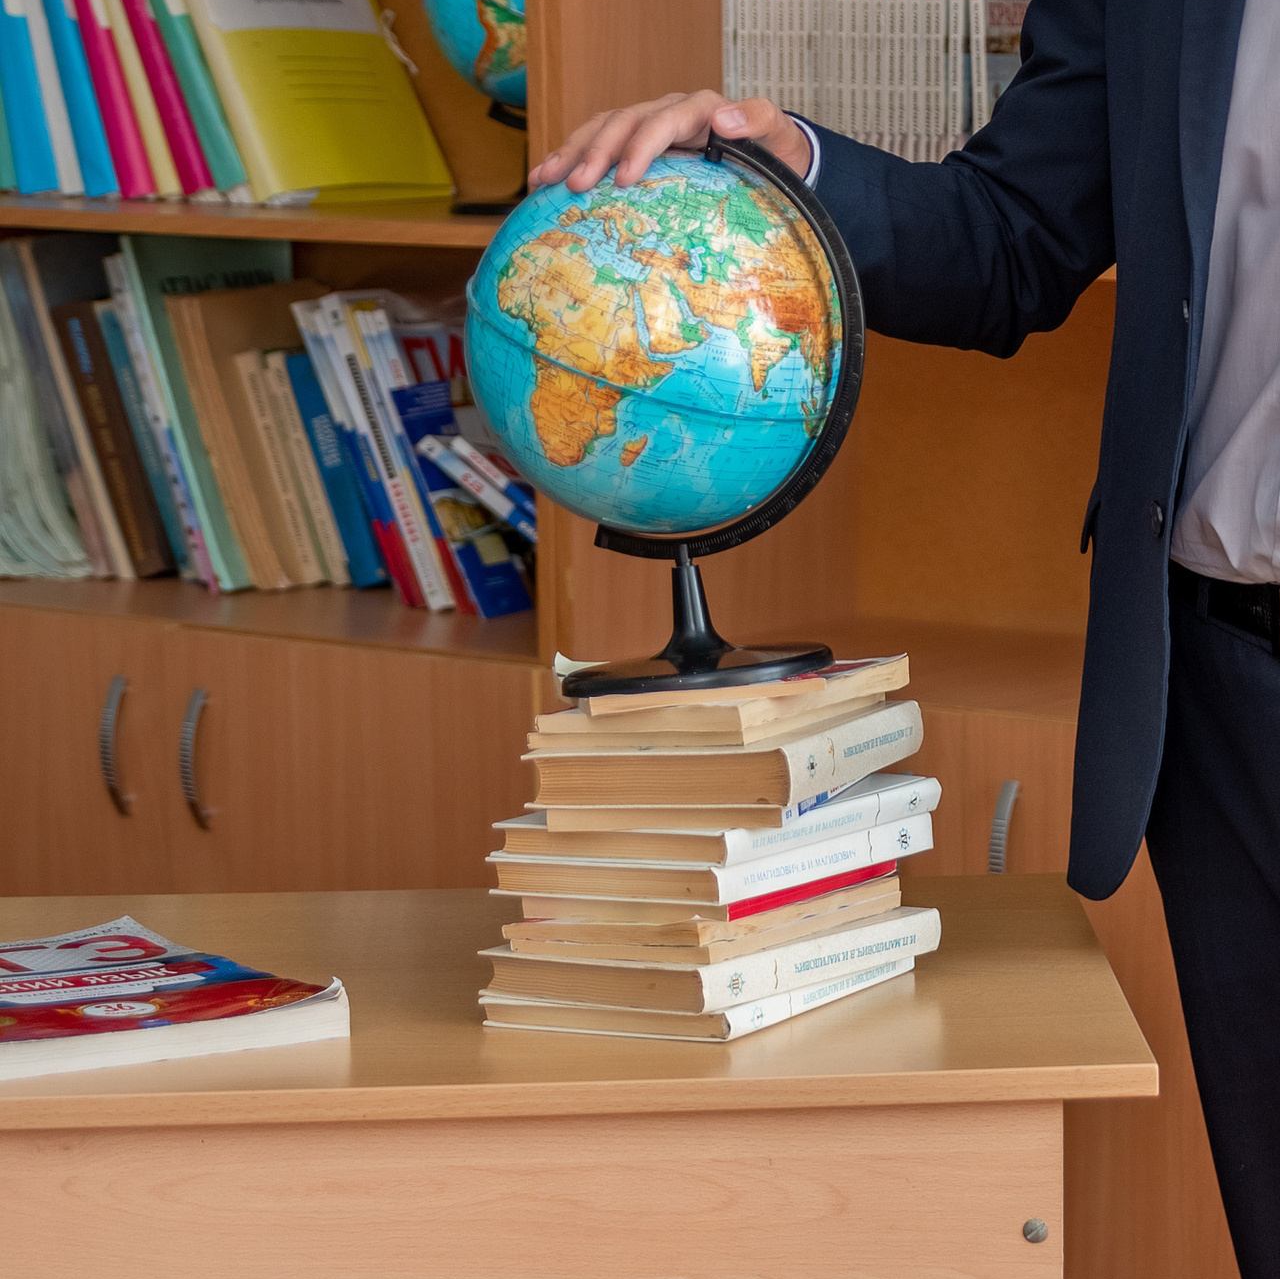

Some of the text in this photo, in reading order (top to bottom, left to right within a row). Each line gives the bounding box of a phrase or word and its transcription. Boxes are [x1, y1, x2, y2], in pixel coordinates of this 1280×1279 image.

[900, 832, 909, 845] IV
[82, 967, 179, 984] ЯЗЫК
[731, 977, 740, 990] III
[95, 1002, 136, 1013] 36
